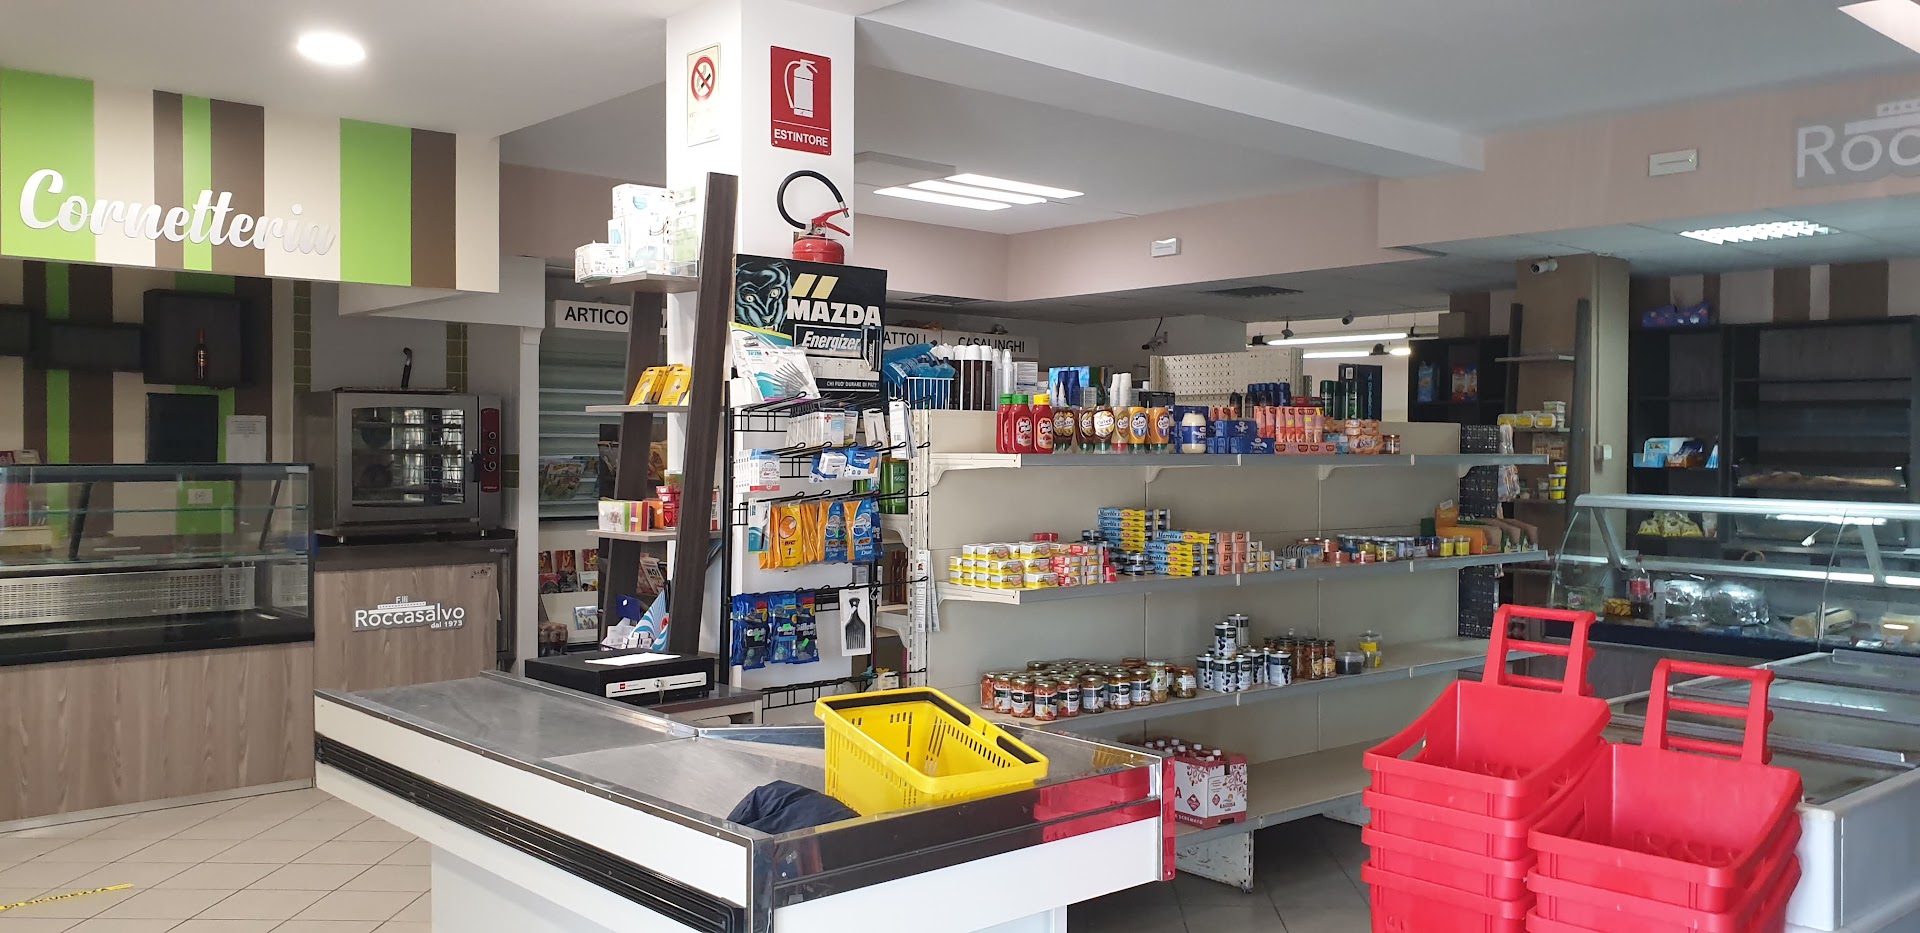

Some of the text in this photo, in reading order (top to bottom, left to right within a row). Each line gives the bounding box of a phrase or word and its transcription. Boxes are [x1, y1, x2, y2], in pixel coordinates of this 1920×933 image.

[774, 129, 829, 147] ESTINTORE
[19, 168, 337, 256] Cornetteria
[564, 306, 629, 325] ARTICO
[786, 298, 882, 327] MAZDA
[801, 330, 861, 351] Energizer
[355, 602, 465, 628] Roccasalvo
[431, 619, 463, 629] dal 1973
